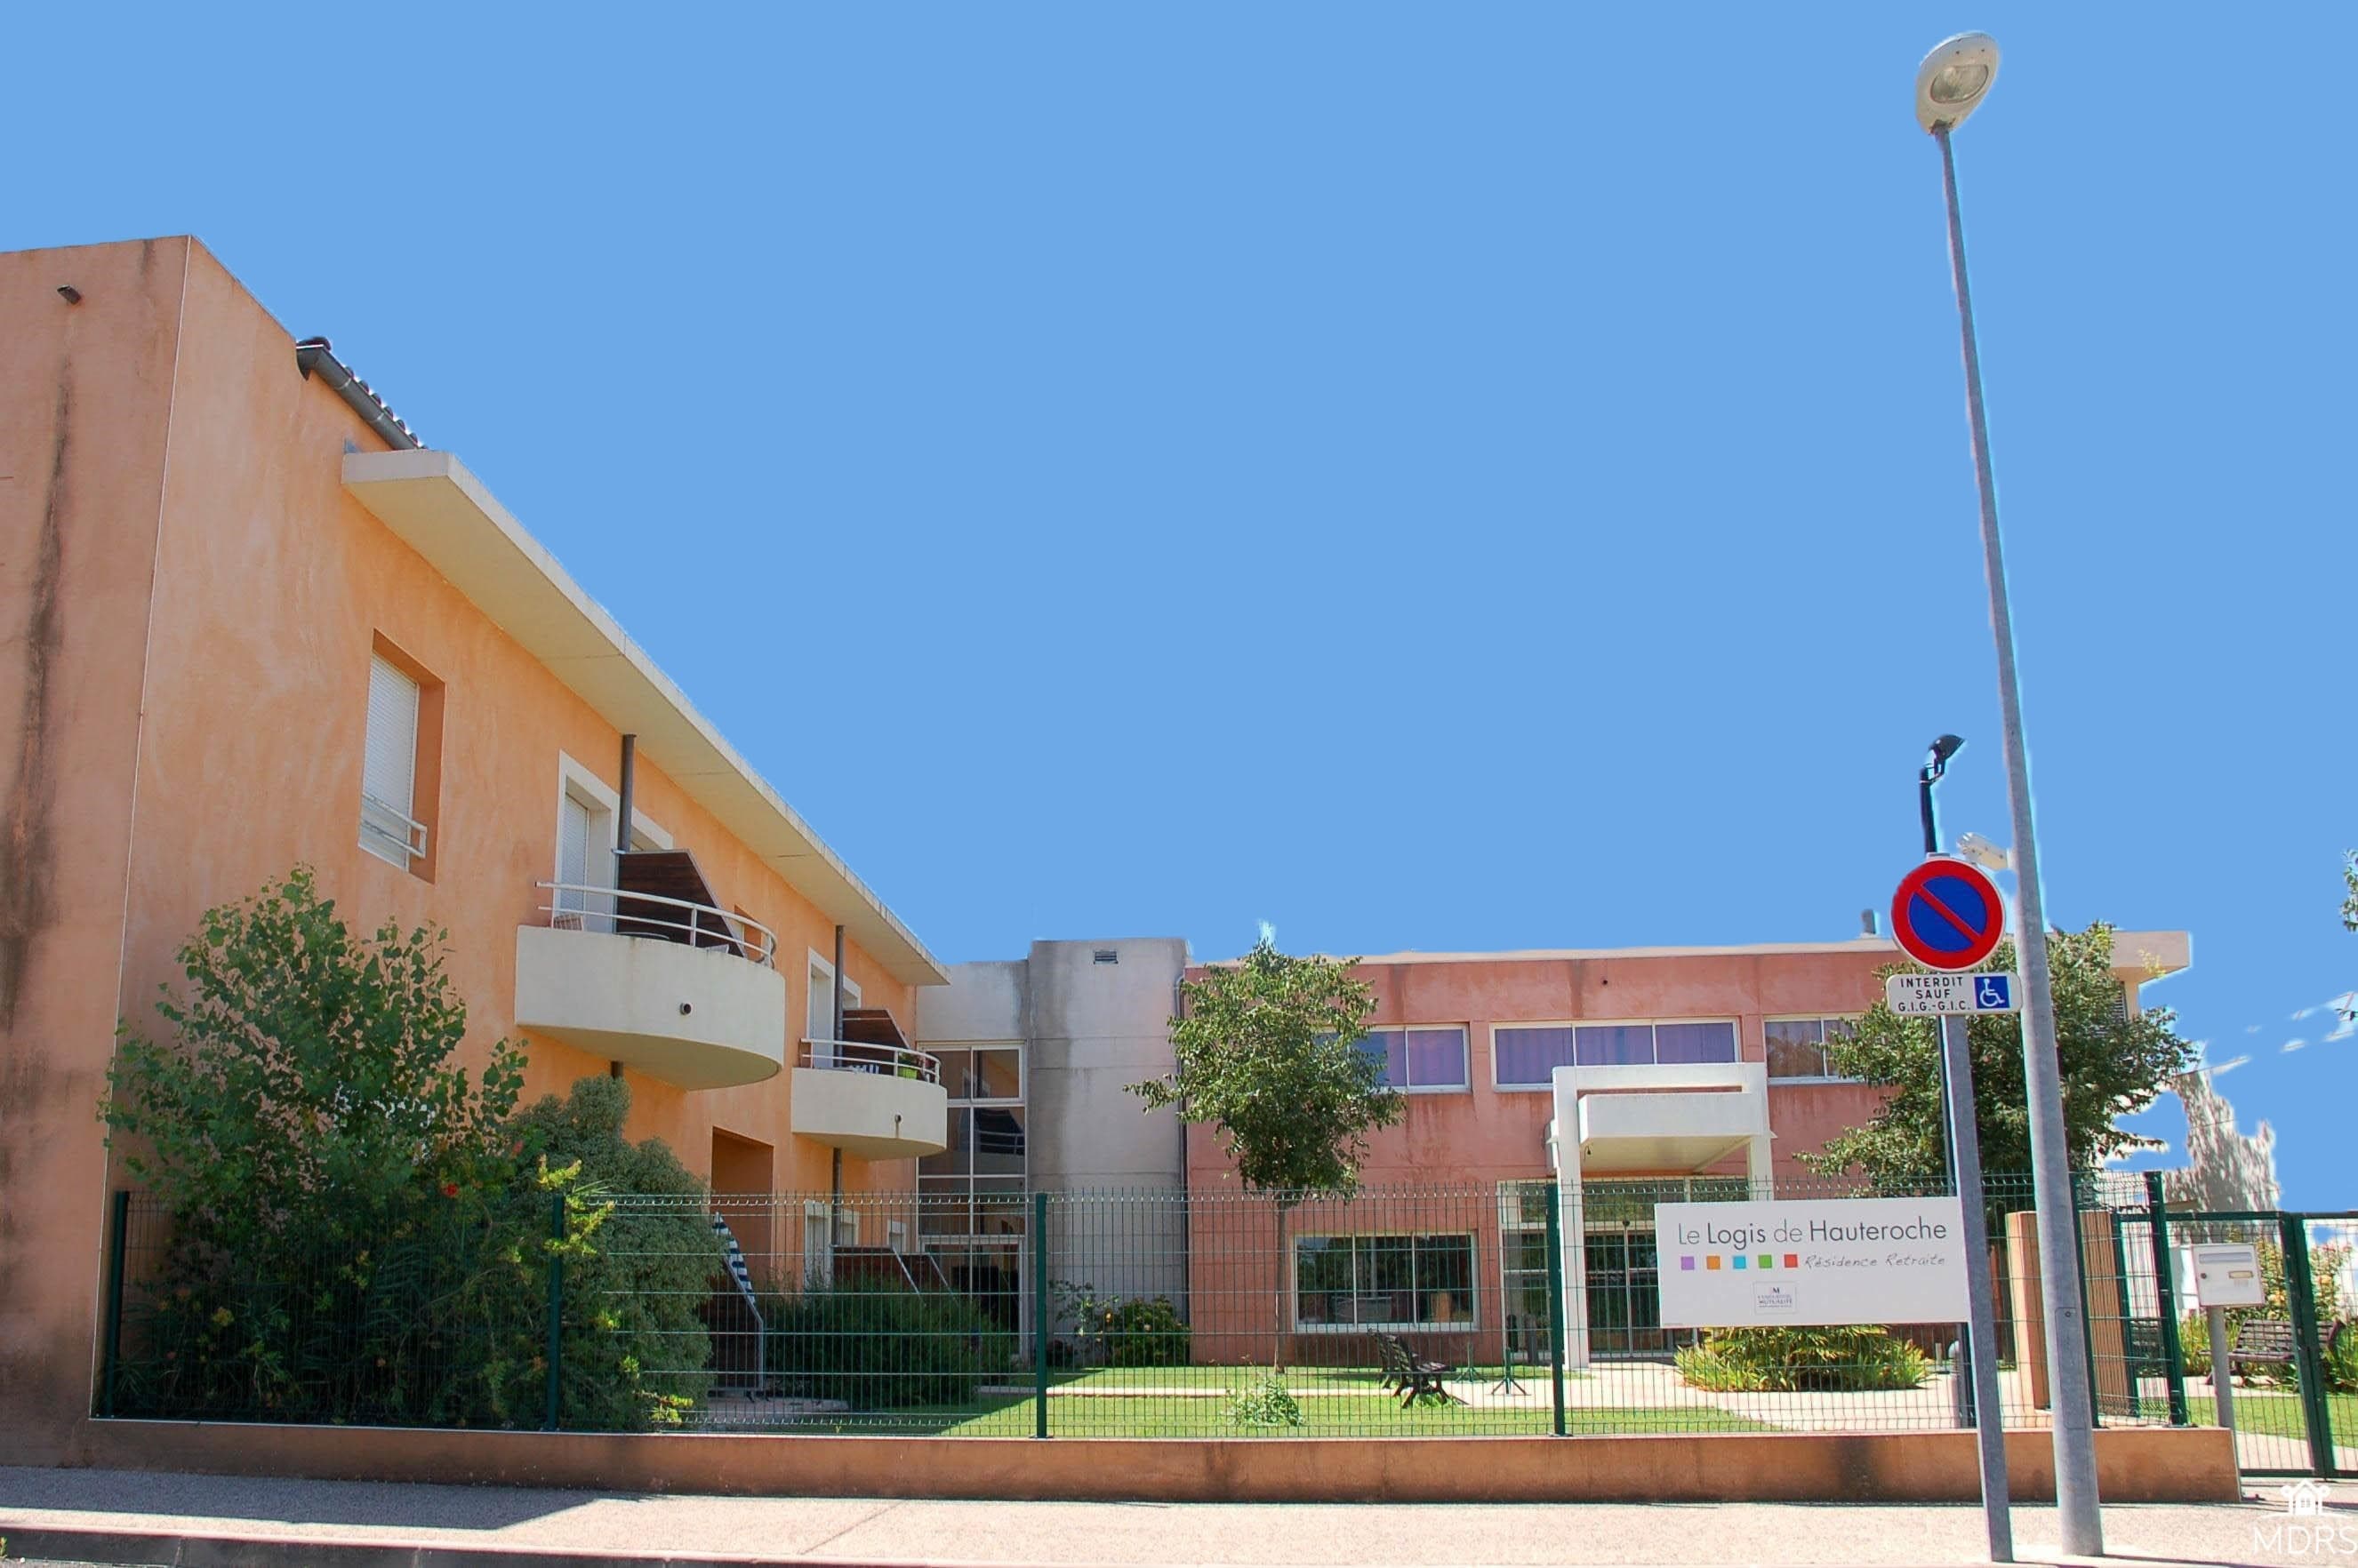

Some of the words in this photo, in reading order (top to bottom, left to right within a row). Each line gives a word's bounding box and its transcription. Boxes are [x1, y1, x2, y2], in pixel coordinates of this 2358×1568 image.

[1900, 976, 1963, 988] INTERDIT
[1916, 988, 1951, 999] SAUF
[1679, 1223, 1700, 1244] Le
[1707, 1222, 1766, 1250] Logis
[1774, 1219, 1802, 1242] de
[1809, 1216, 1946, 1243] Hauteroche
[1805, 1254, 1878, 1268] Résidence
[1885, 1254, 1945, 1267] Retraite
